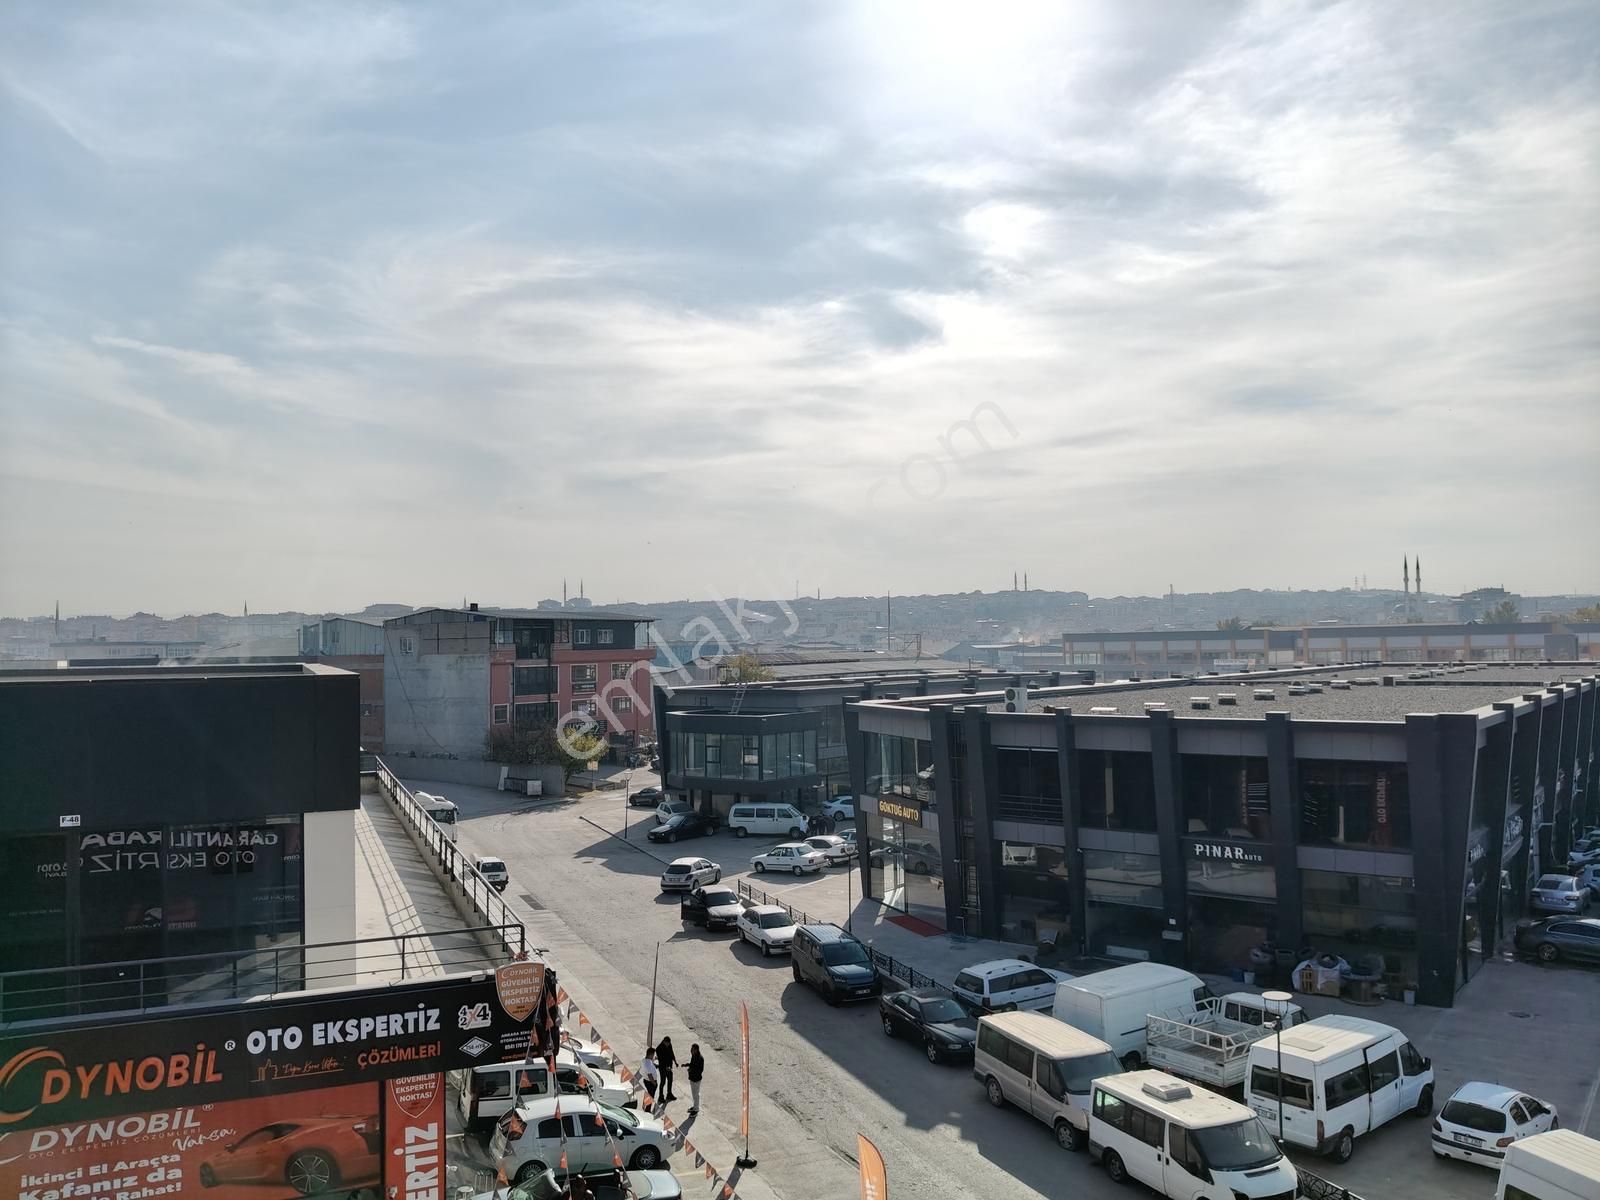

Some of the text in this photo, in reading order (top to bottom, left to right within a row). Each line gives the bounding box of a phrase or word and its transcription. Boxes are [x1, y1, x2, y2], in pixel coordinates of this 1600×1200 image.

[903, 806, 919, 821] AUTO
[1193, 843, 1263, 862] PINAR AUTO
[501, 986, 541, 998] EKSPERTİZ
[246, 1003, 441, 1055] OTO EKSPERTİZ
[357, 1040, 441, 1072] ÇÖZÜMLERİ
[41, 1042, 224, 1105] DYNOBİL
[395, 1081, 436, 1094] EKSPERTİZ
[400, 1091, 433, 1103] NOKTASI
[29, 1107, 201, 1153] DYNOBİL
[20, 1153, 182, 1189] İkinci El Araçta
[145, 1167, 183, 1186] da
